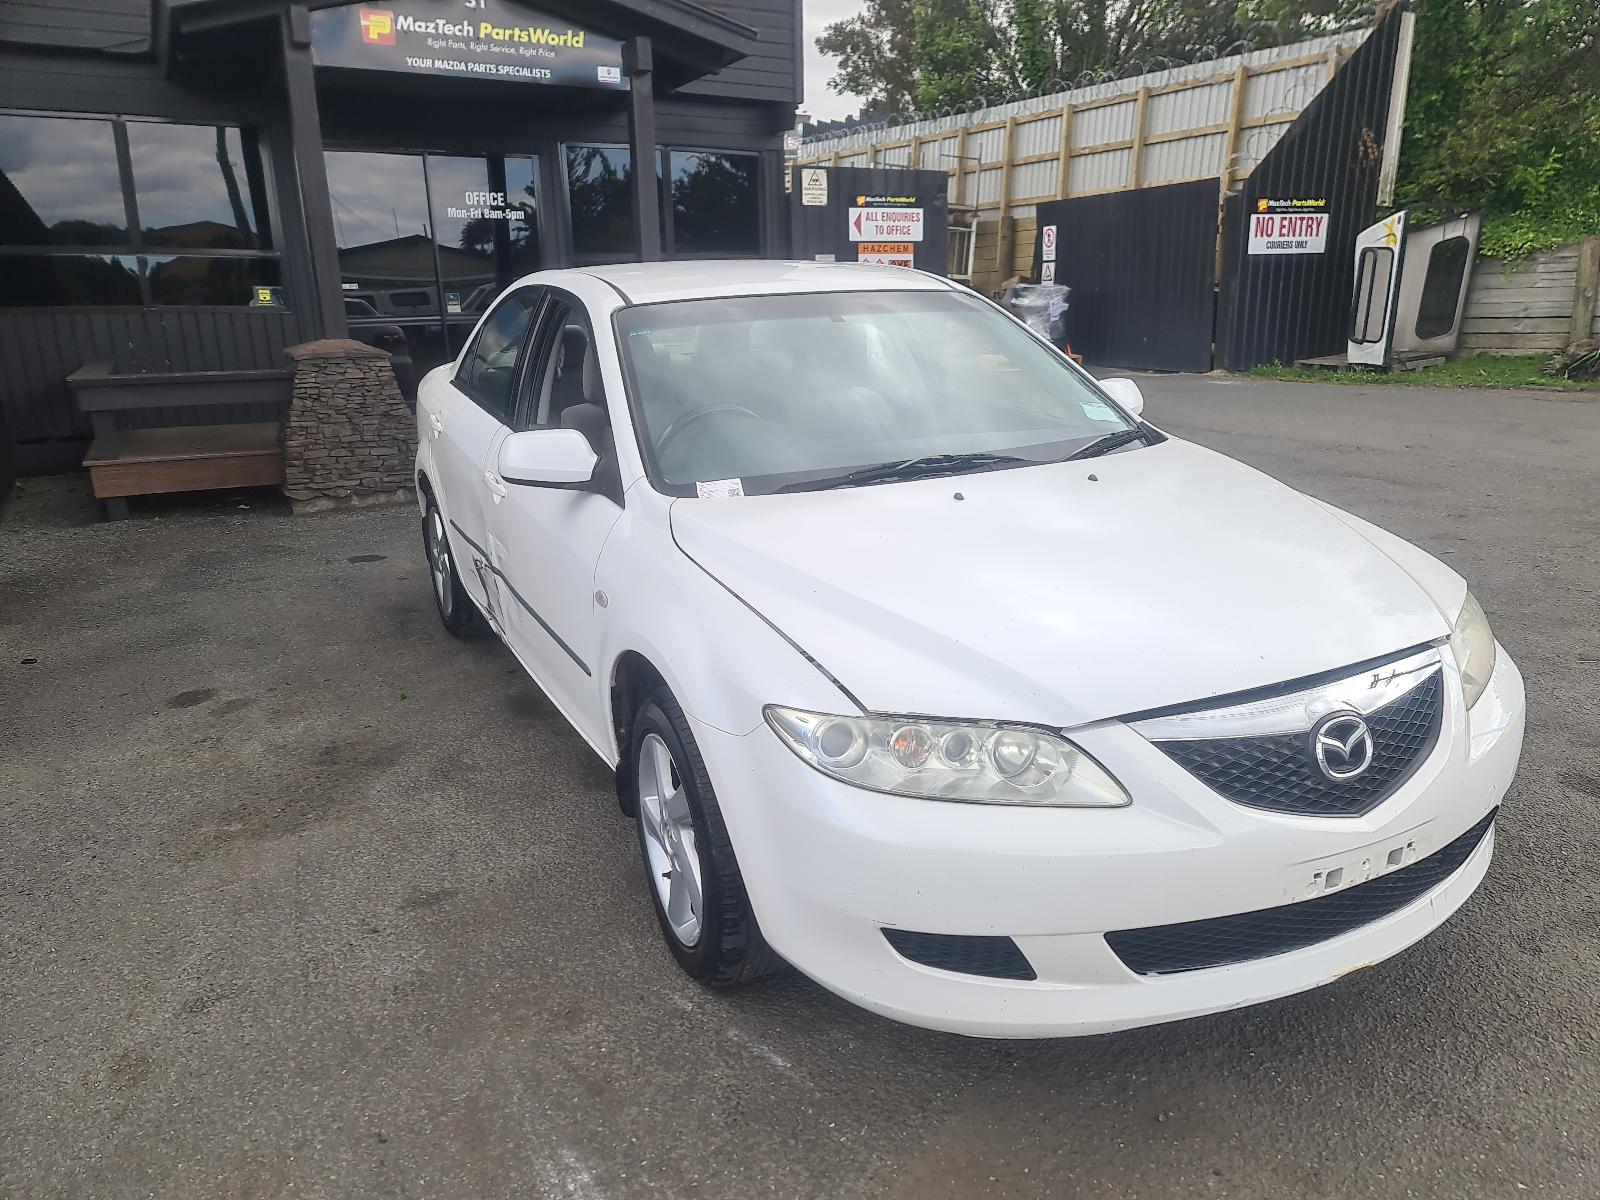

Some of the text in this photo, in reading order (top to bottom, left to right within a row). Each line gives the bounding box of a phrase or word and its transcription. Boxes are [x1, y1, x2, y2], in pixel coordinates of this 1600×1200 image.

[396, 15, 585, 48] MazTech PartsWorld
[426, 37, 556, 58] Right Parts, Right Service, Right Price
[405, 56, 551, 78] YOUR MAZDA PARTS SPECIALISTS
[465, 191, 505, 206] OFFICE
[1268, 198, 1326, 207] MazTech PartsWorld
[447, 207, 525, 220] Mon-Fri 8am-5pm
[865, 211, 921, 224] ALL ENQUIRIES
[875, 224, 912, 236] TO OFFICE
[1254, 217, 1323, 237] NO ENTRY
[863, 244, 910, 253] HAZCHEM
[1266, 240, 1308, 249] COURIERS ONLY
